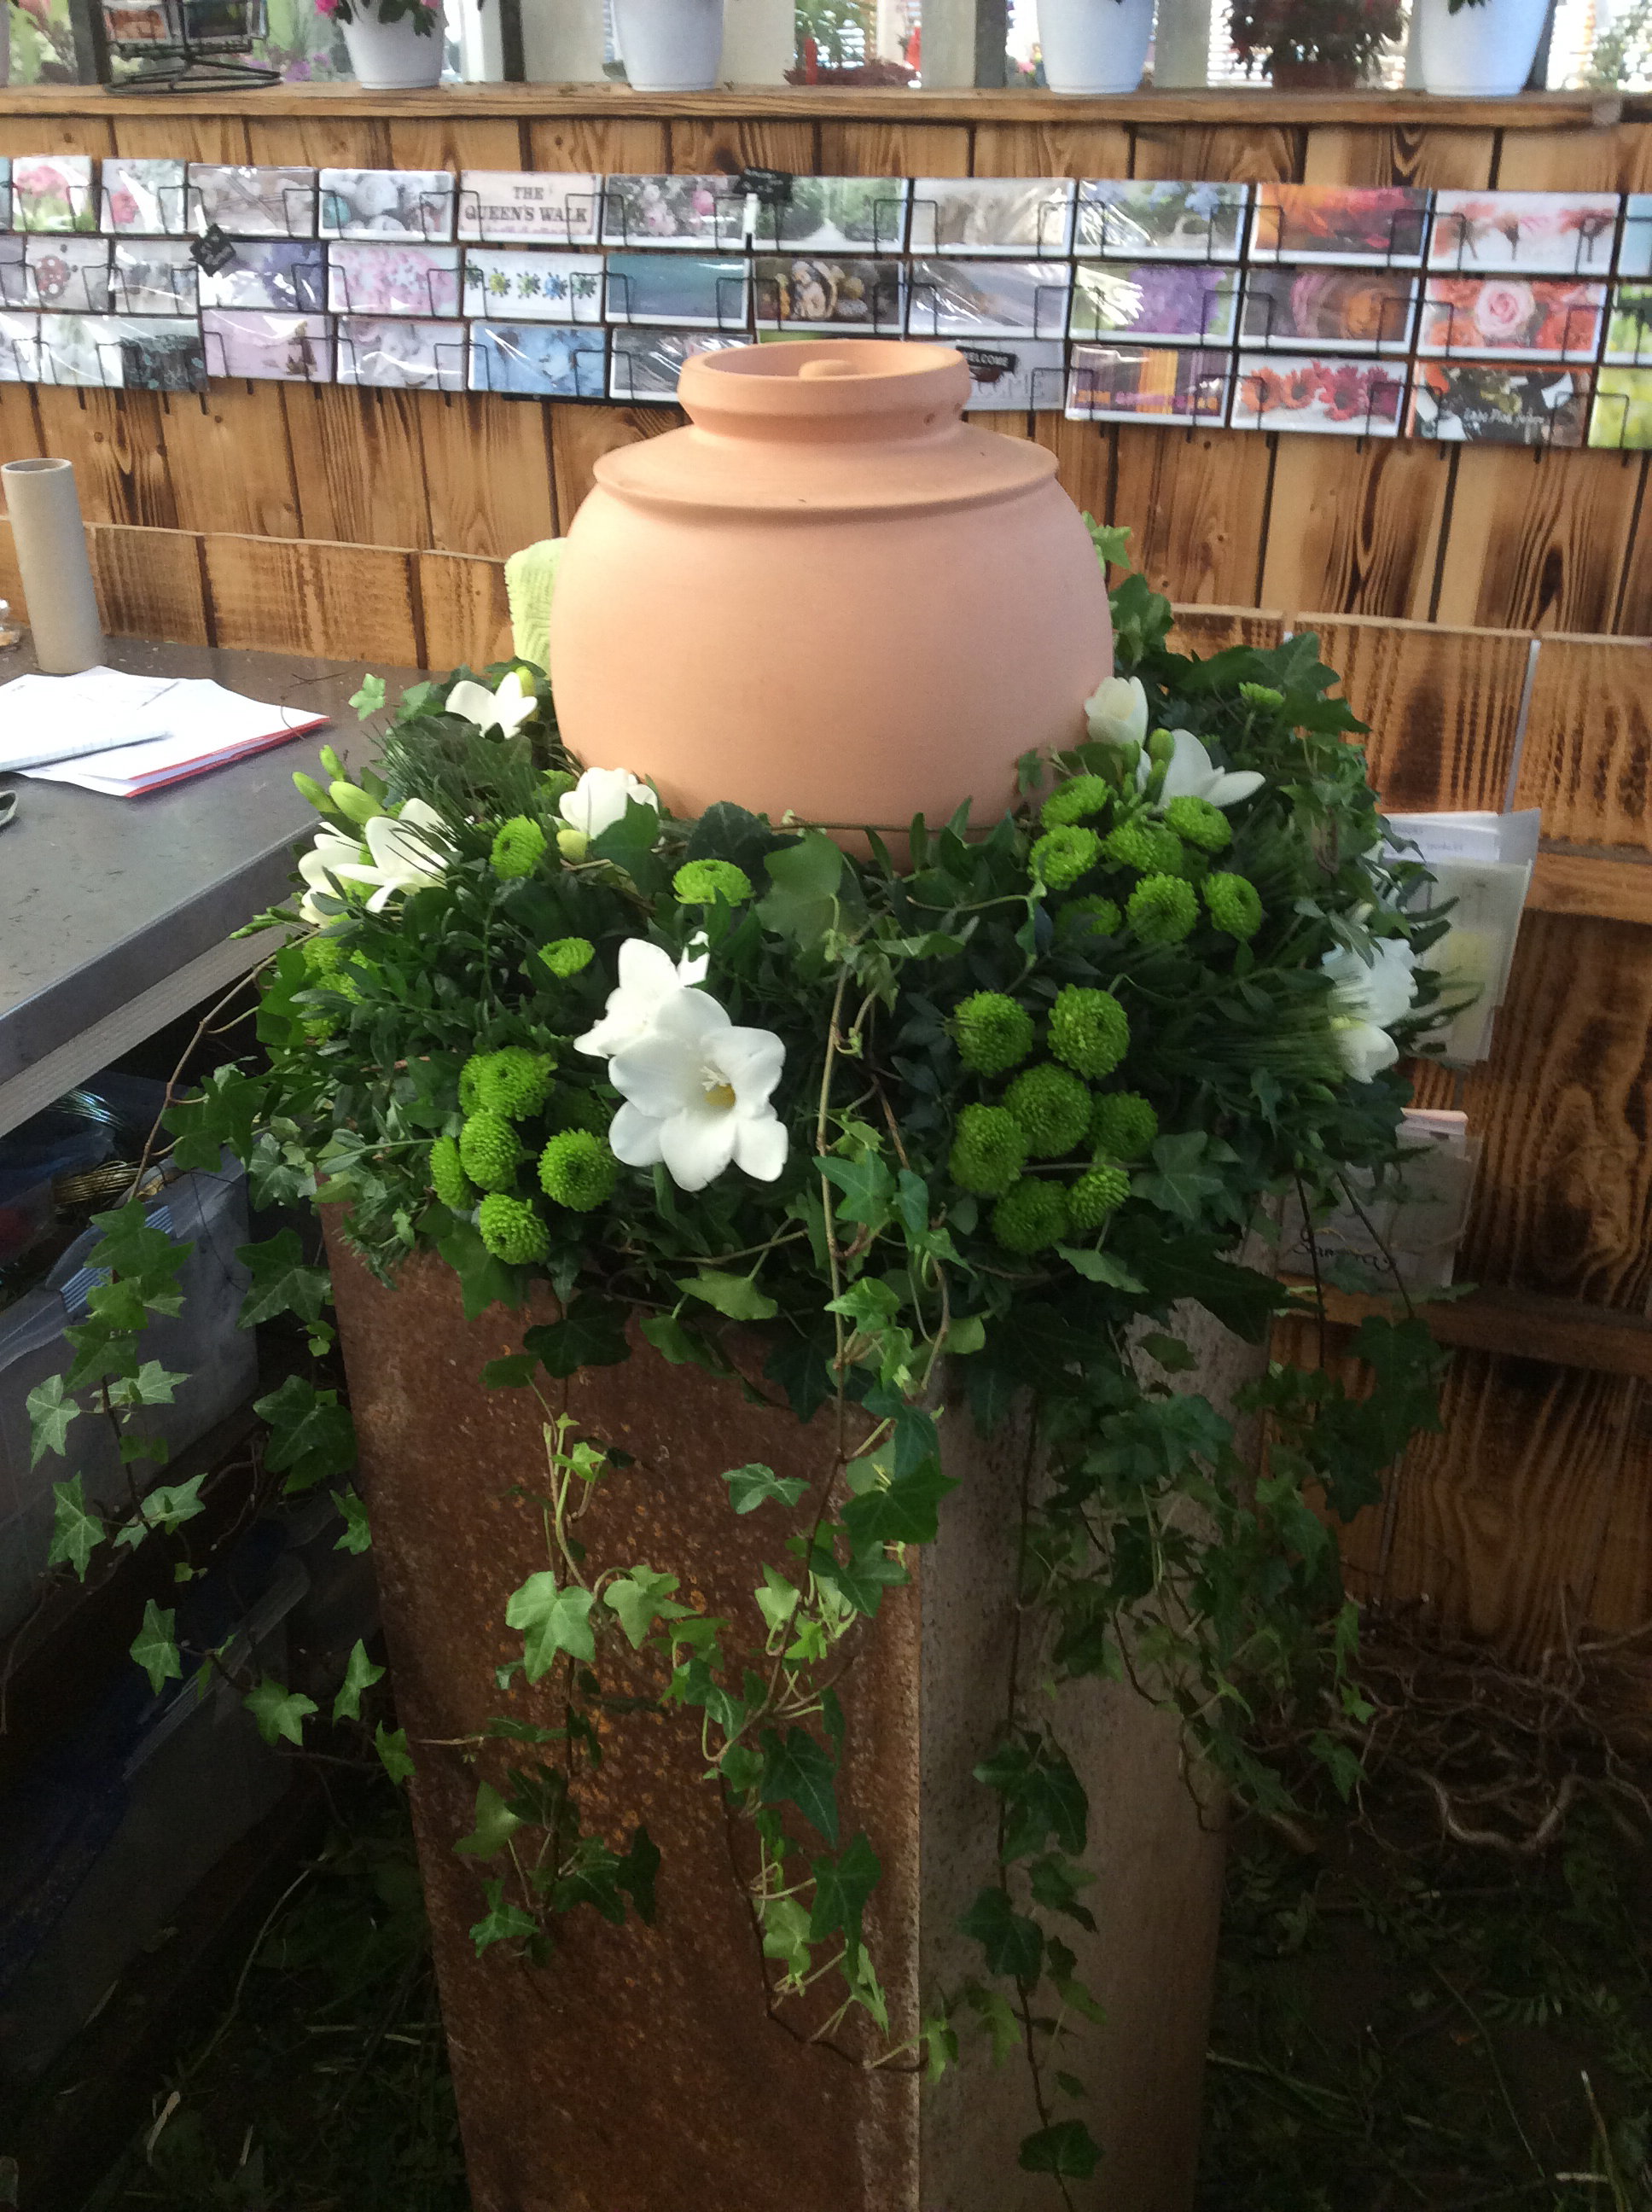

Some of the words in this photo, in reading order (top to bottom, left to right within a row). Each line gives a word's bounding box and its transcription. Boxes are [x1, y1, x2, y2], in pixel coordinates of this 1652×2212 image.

[513, 186, 544, 200] THE
[465, 205, 534, 221] QUEEN'S
[539, 207, 587, 222] WALK
